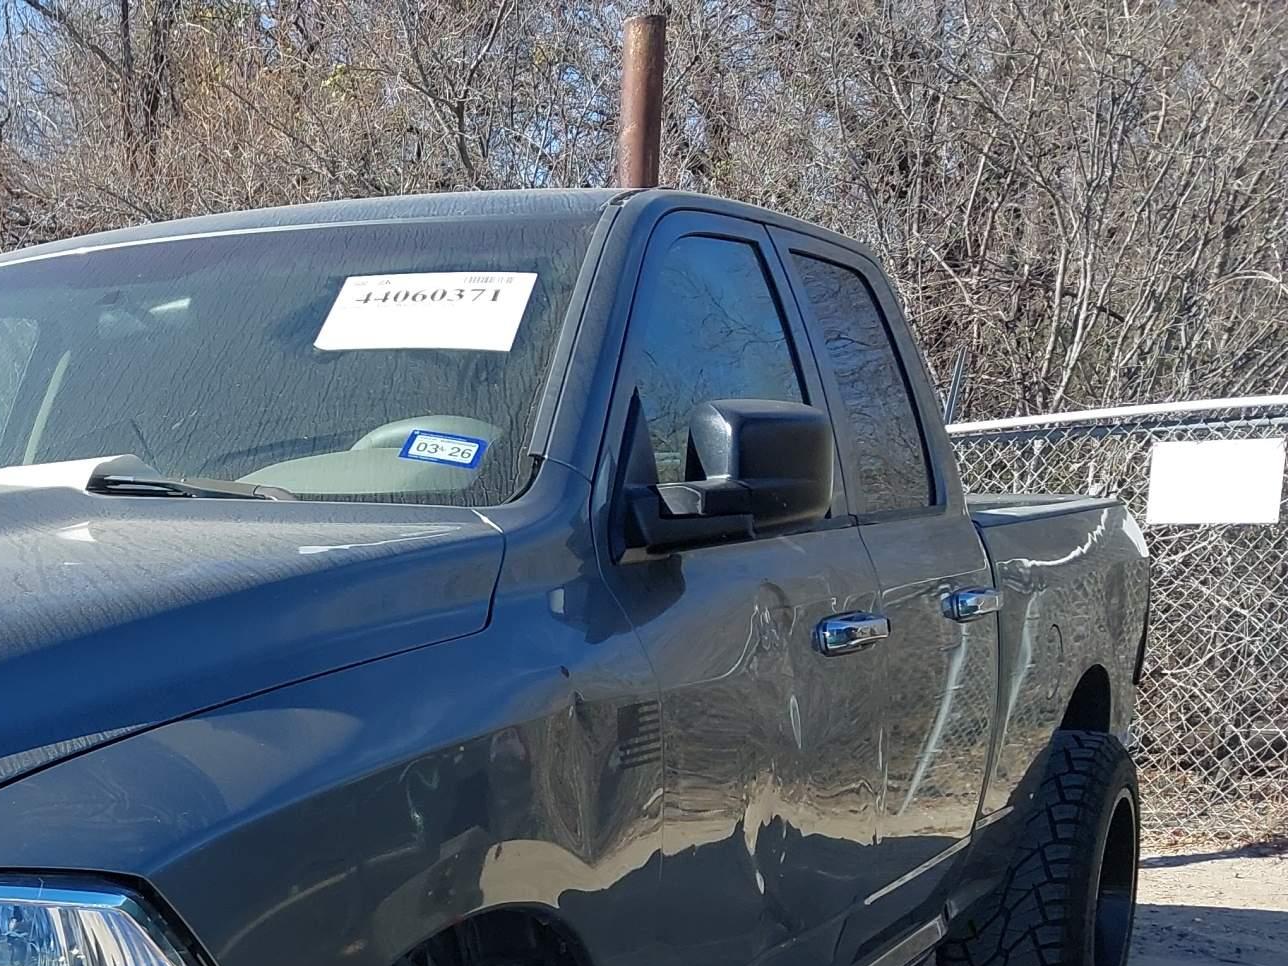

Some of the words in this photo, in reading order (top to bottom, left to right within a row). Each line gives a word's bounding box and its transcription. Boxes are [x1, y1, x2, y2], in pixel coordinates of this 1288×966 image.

[355, 288, 502, 304] 44060371
[415, 441, 440, 455] 03
[447, 446, 473, 459] 26
